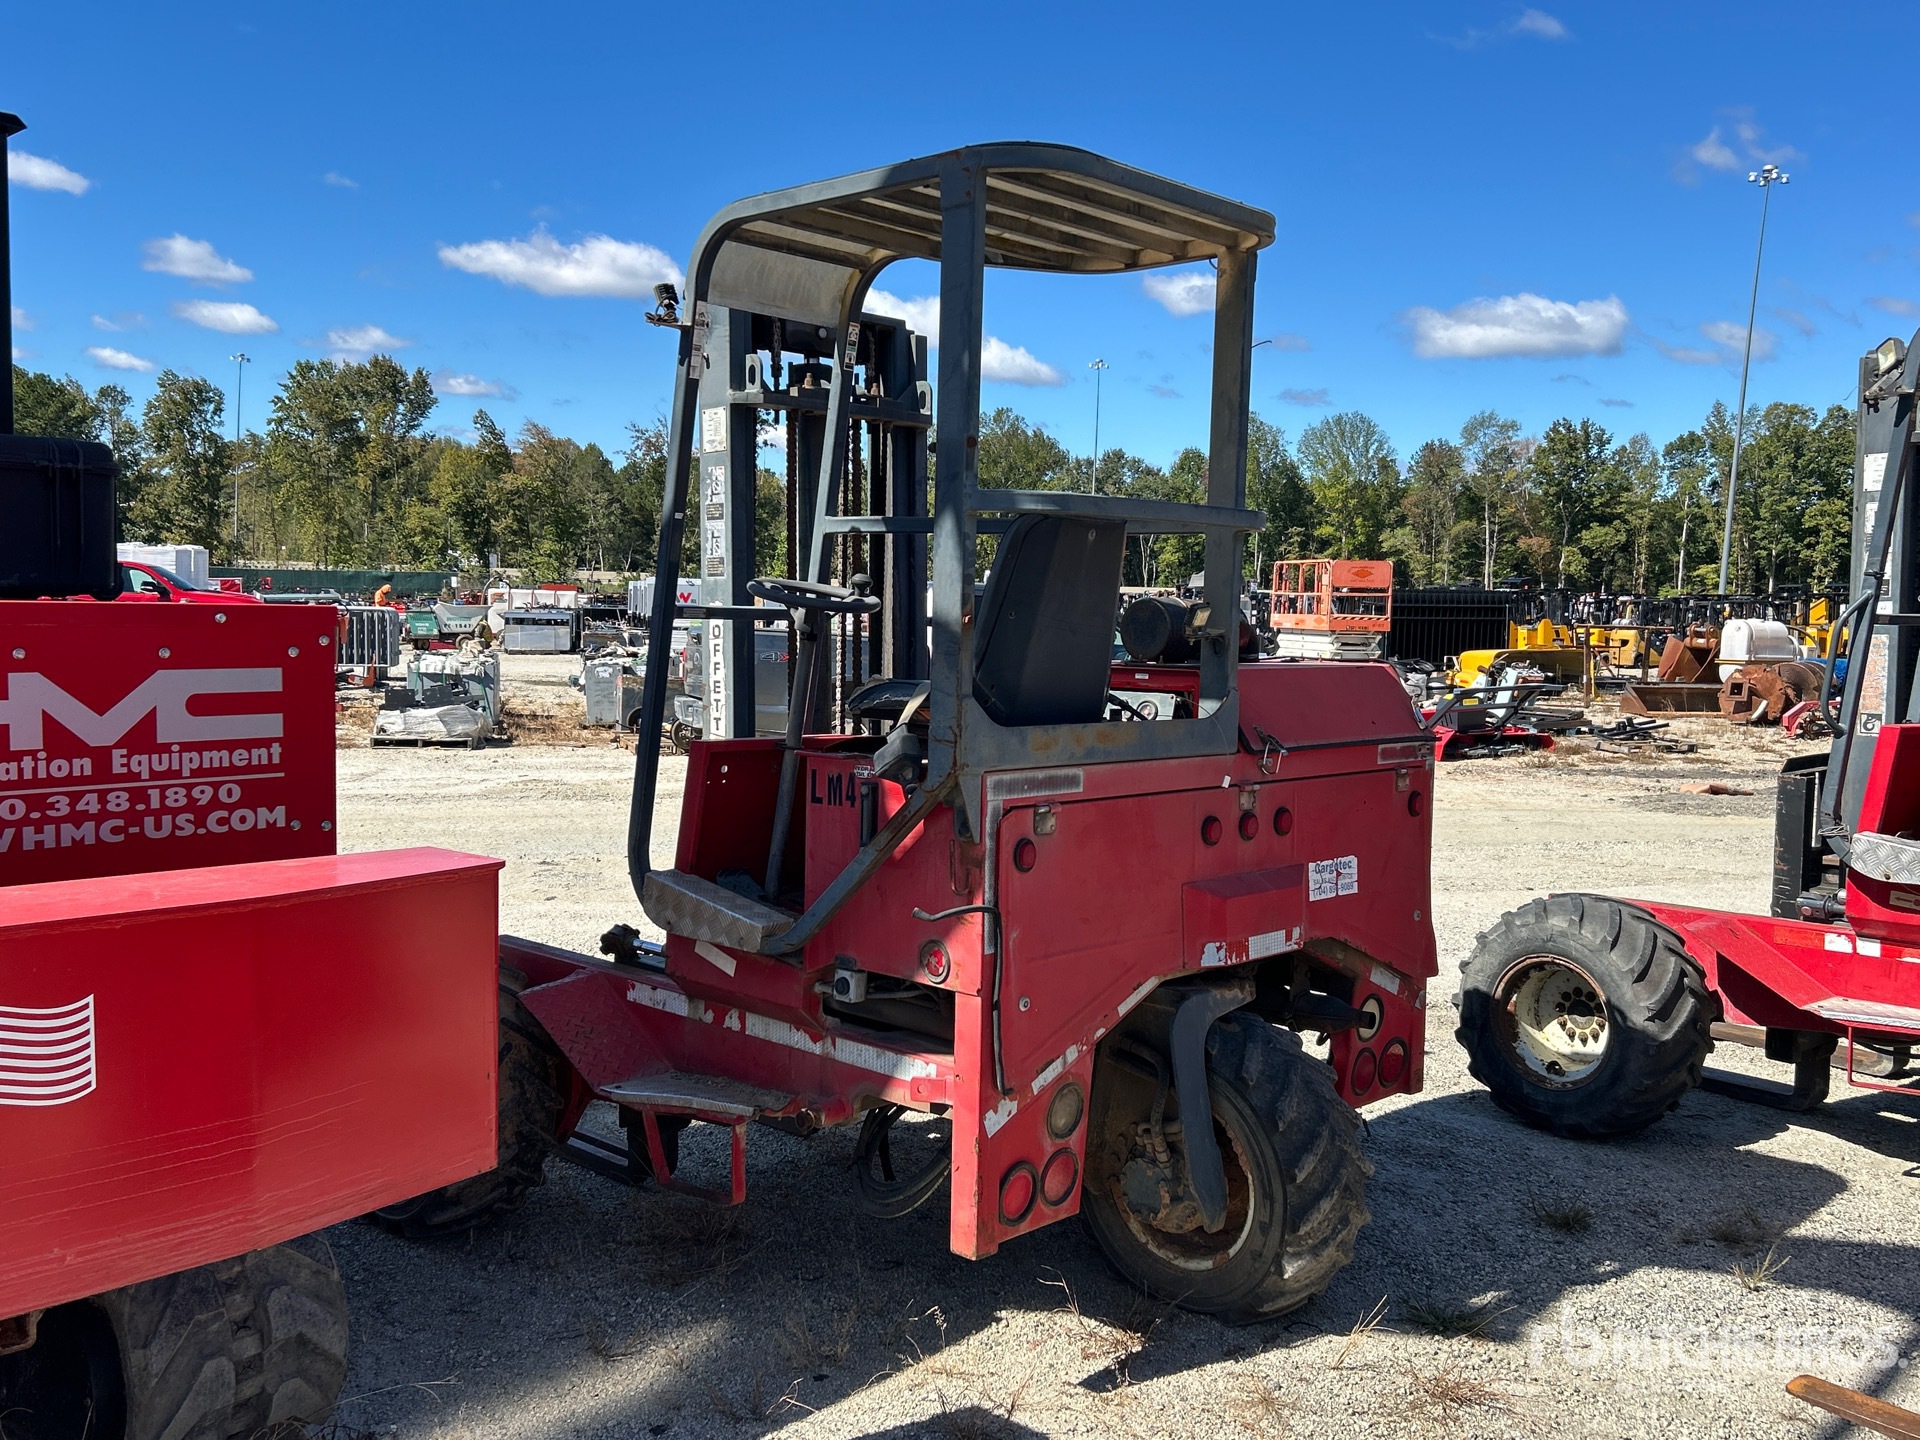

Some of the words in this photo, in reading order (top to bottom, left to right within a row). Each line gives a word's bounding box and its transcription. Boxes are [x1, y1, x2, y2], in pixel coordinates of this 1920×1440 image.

[712, 624, 721, 730] OFFETT
[0, 751, 92, 781] ation
[112, 743, 282, 779] Equipment
[0, 783, 242, 821] 0.348.1890
[811, 769, 856, 807] LM4
[1314, 859, 1353, 875] Cargotec
